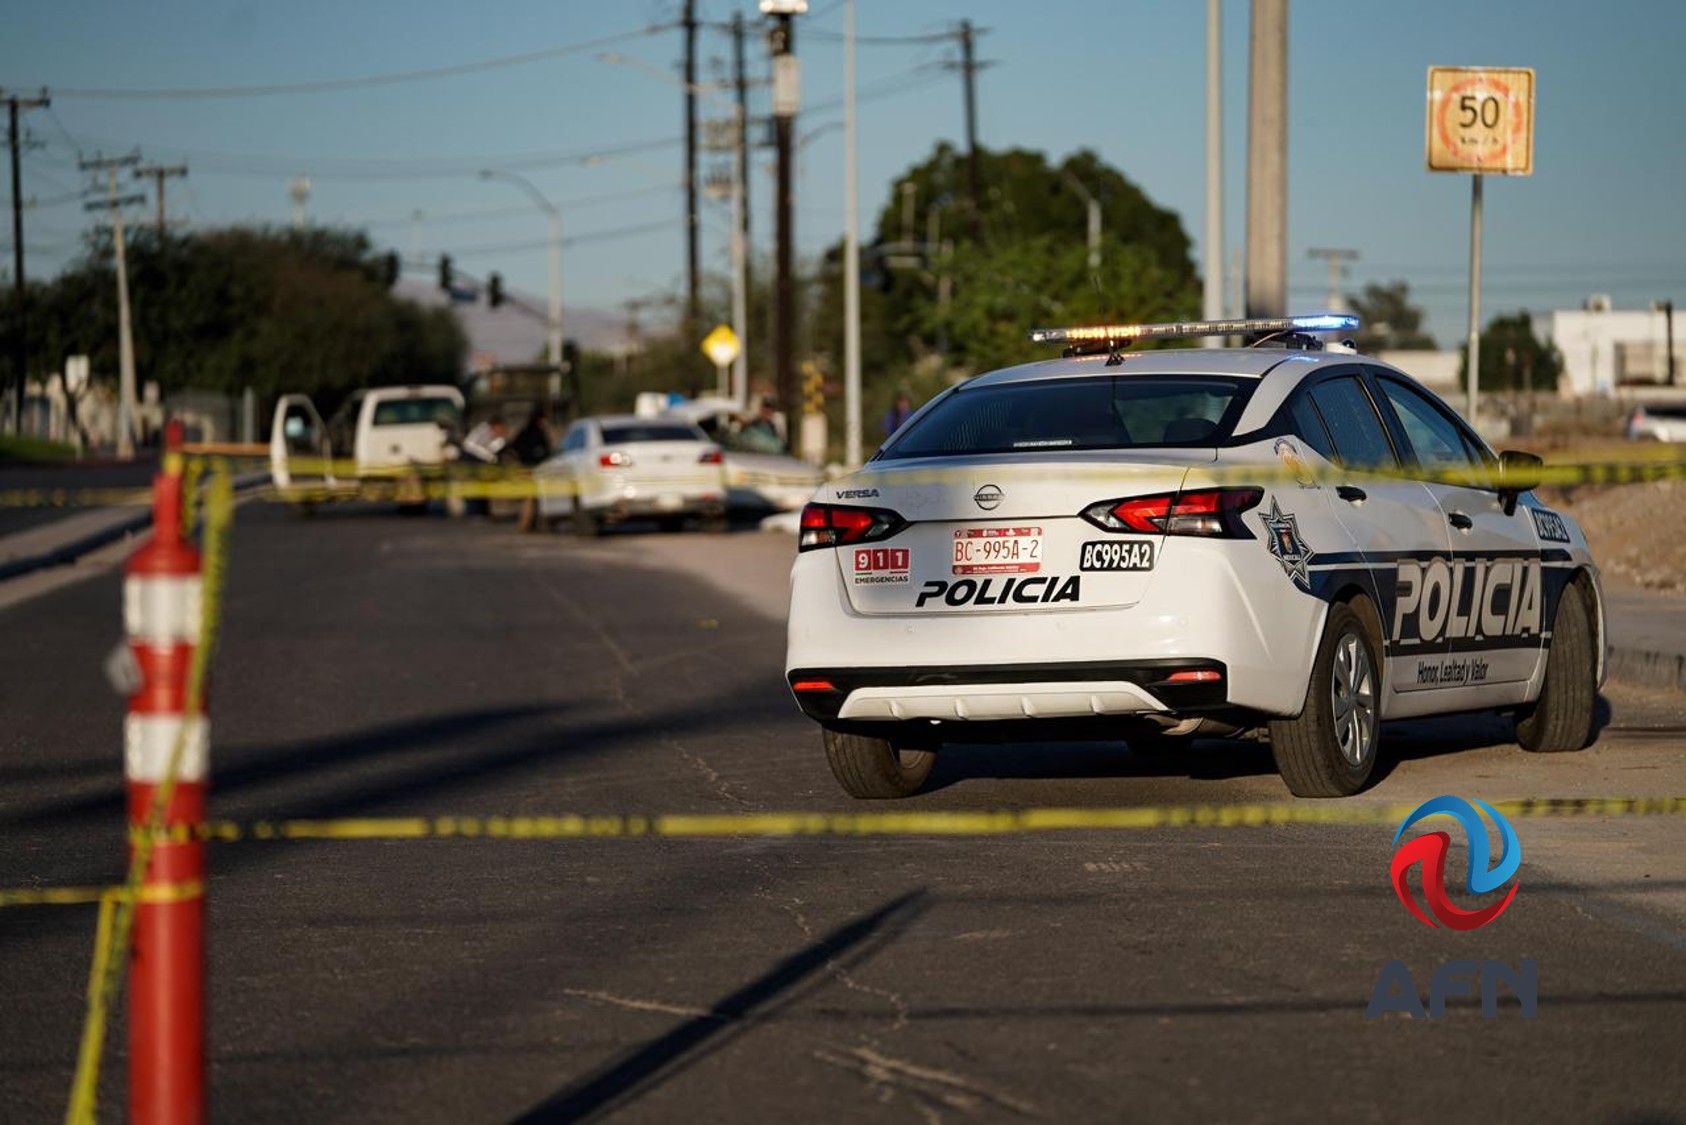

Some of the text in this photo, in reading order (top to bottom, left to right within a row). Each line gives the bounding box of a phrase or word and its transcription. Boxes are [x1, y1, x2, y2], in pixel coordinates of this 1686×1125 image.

[1459, 96, 1499, 128] 50
[836, 489, 880, 499] VERSA
[858, 551, 904, 569] 911
[955, 540, 1039, 562] BC-995A-2
[1082, 543, 1151, 569] BC995A2
[855, 575, 909, 584] EMERGENCIAS
[915, 575, 1080, 607] POLICIA
[1392, 556, 1542, 642] POLICIA
[1440, 658, 1466, 682] Lealtad
[1471, 657, 1489, 681] Valor
